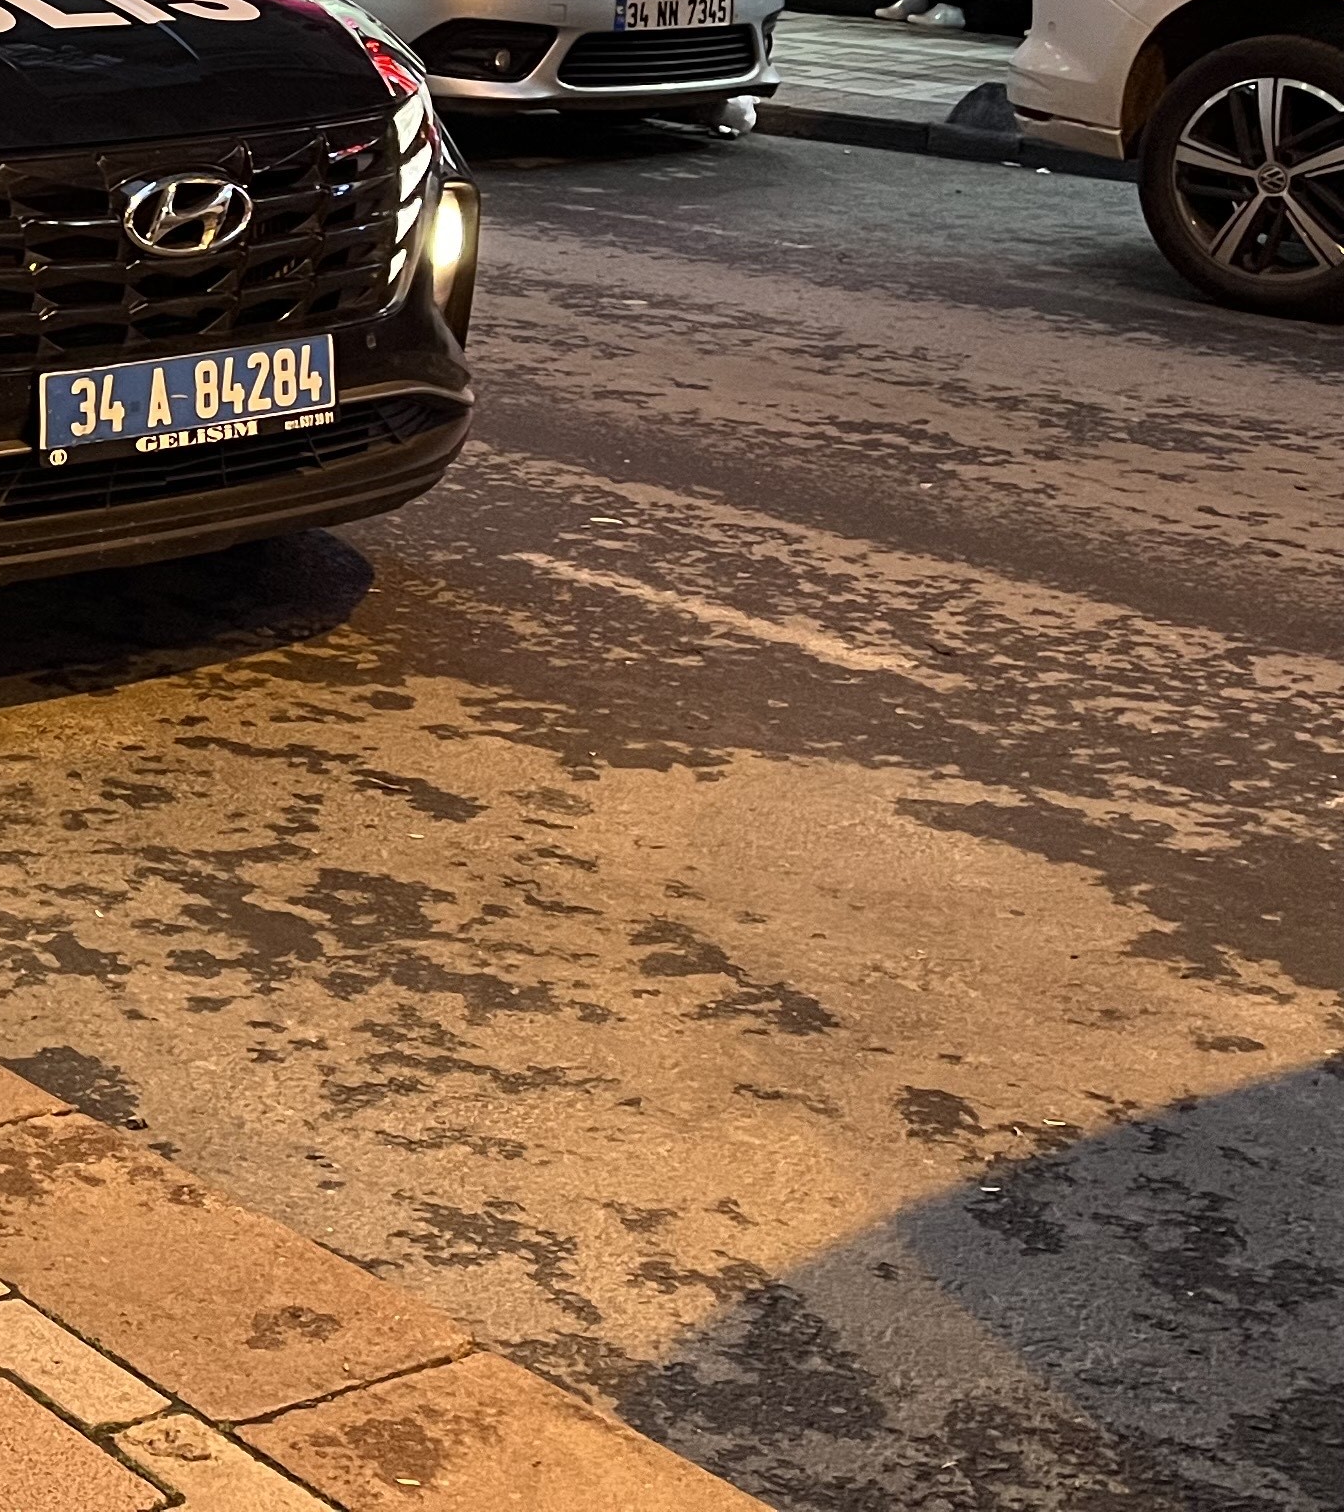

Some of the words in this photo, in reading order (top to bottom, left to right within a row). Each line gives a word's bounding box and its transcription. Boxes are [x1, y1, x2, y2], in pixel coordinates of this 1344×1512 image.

[627, 2, 649, 28] 34
[71, 374, 125, 437] 34
[147, 367, 172, 428] A
[194, 344, 323, 419] 84284
